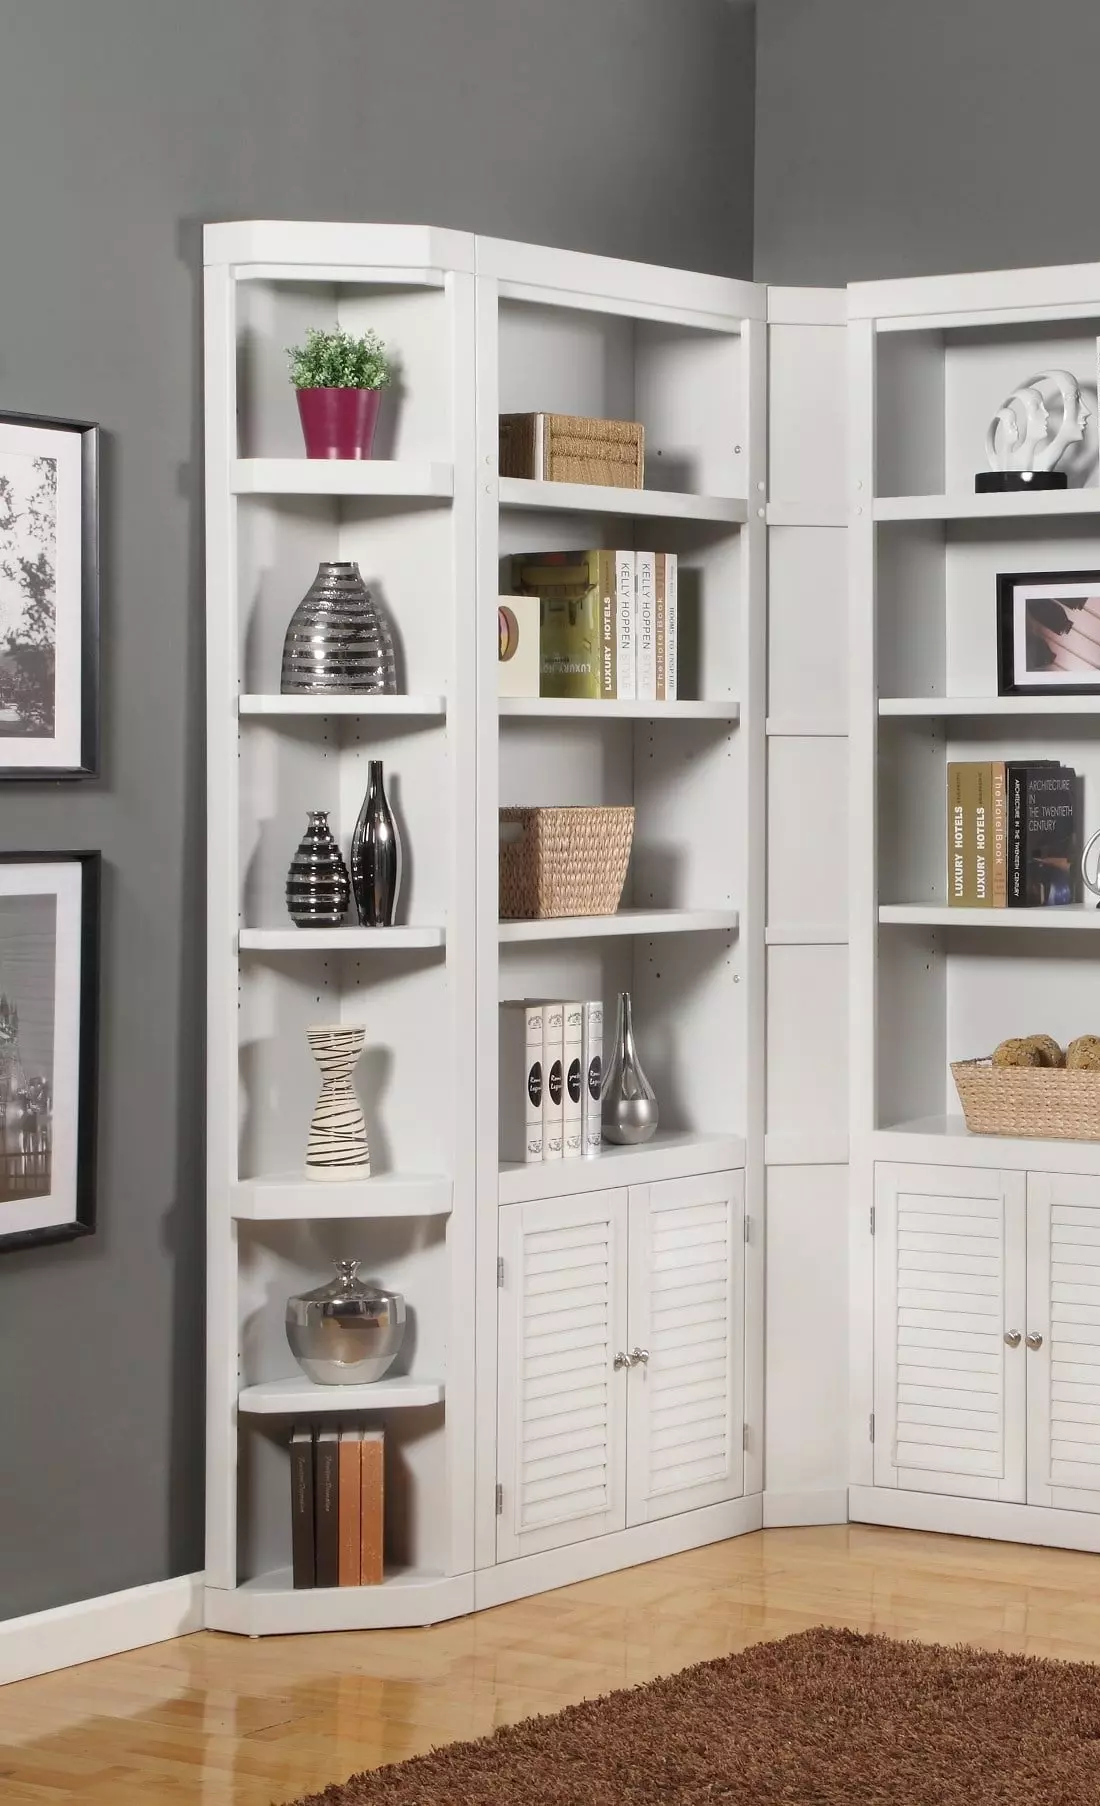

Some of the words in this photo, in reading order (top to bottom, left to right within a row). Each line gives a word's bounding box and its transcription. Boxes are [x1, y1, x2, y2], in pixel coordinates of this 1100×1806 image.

[620, 562, 630, 598] KELLY
[641, 563, 651, 598] KELLY
[603, 596, 611, 640] HOTELS
[620, 601, 630, 649] HOPPEN
[641, 601, 651, 650] HOPPEN
[604, 646, 612, 691] LUXURY
[1028, 779, 1071, 791] ARCHITECTURE
[1028, 793, 1037, 804] IN
[954, 806, 963, 849] HOTELS
[976, 807, 985, 850] HOTELS
[1028, 806, 1040, 818] THE
[1041, 805, 1074, 817] TWENTIETH
[1028, 820, 1057, 832] CENTURY
[954, 853, 963, 897] LUXURY
[976, 855, 985, 898] LUXURY
